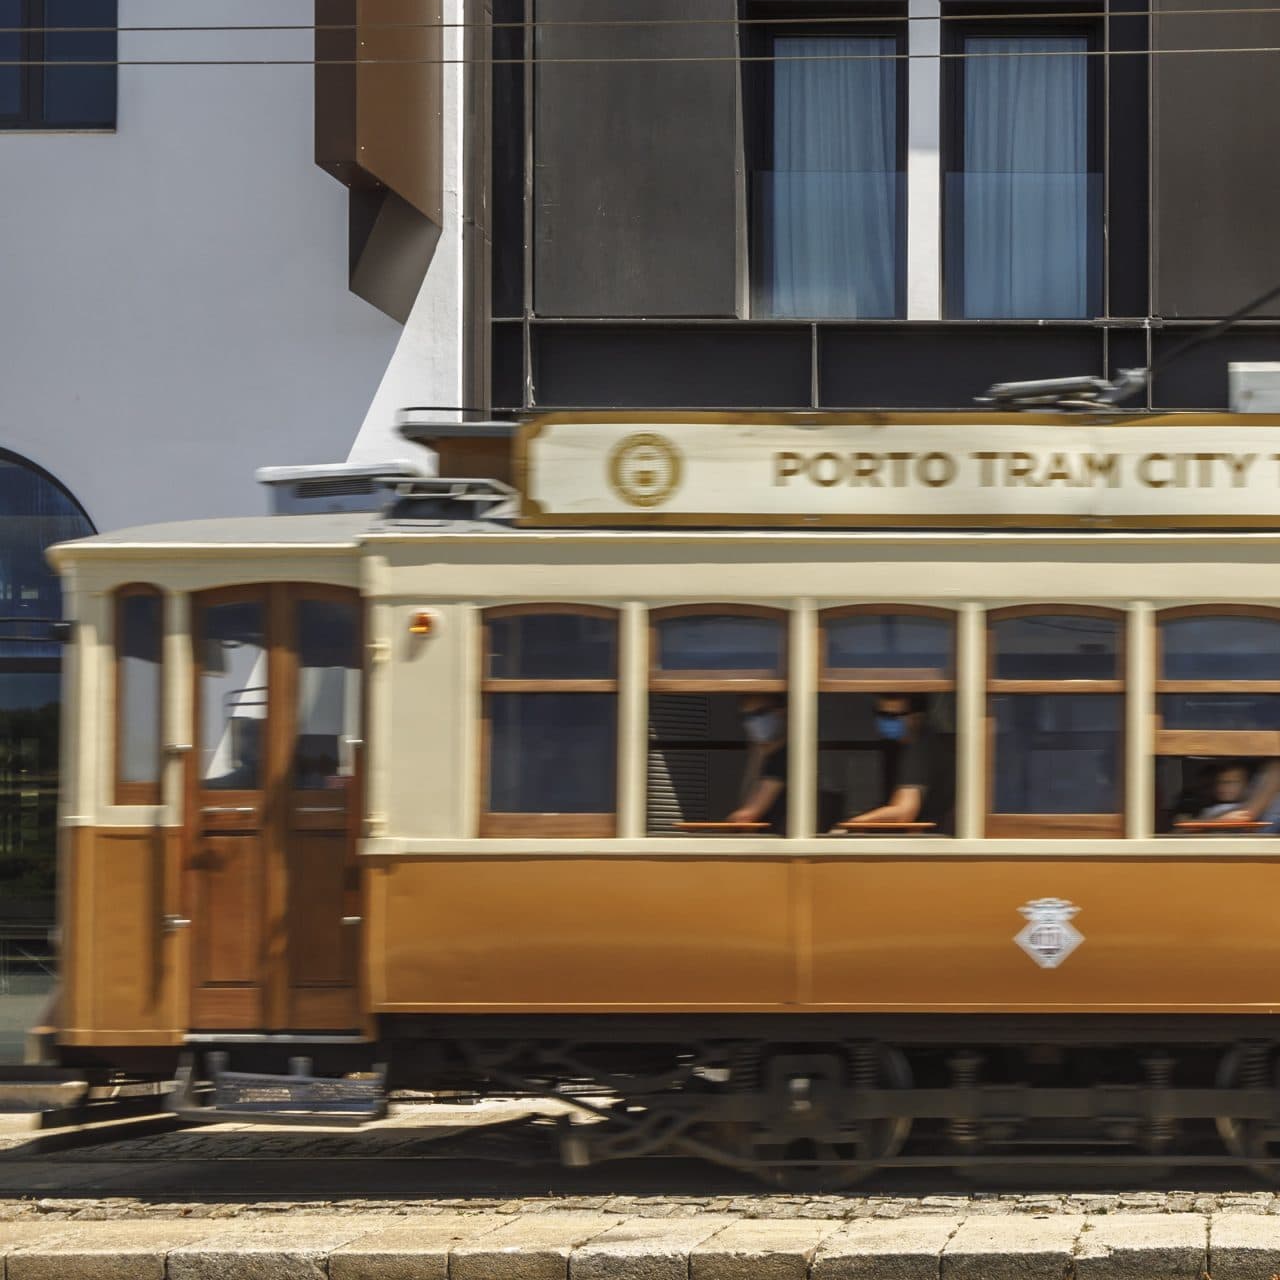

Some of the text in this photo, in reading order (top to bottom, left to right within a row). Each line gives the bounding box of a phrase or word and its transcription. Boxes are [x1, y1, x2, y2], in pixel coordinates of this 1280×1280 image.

[772, 451, 957, 488] PORTO
[968, 451, 1123, 489] TRAM
[1136, 452, 1256, 489] CITY
